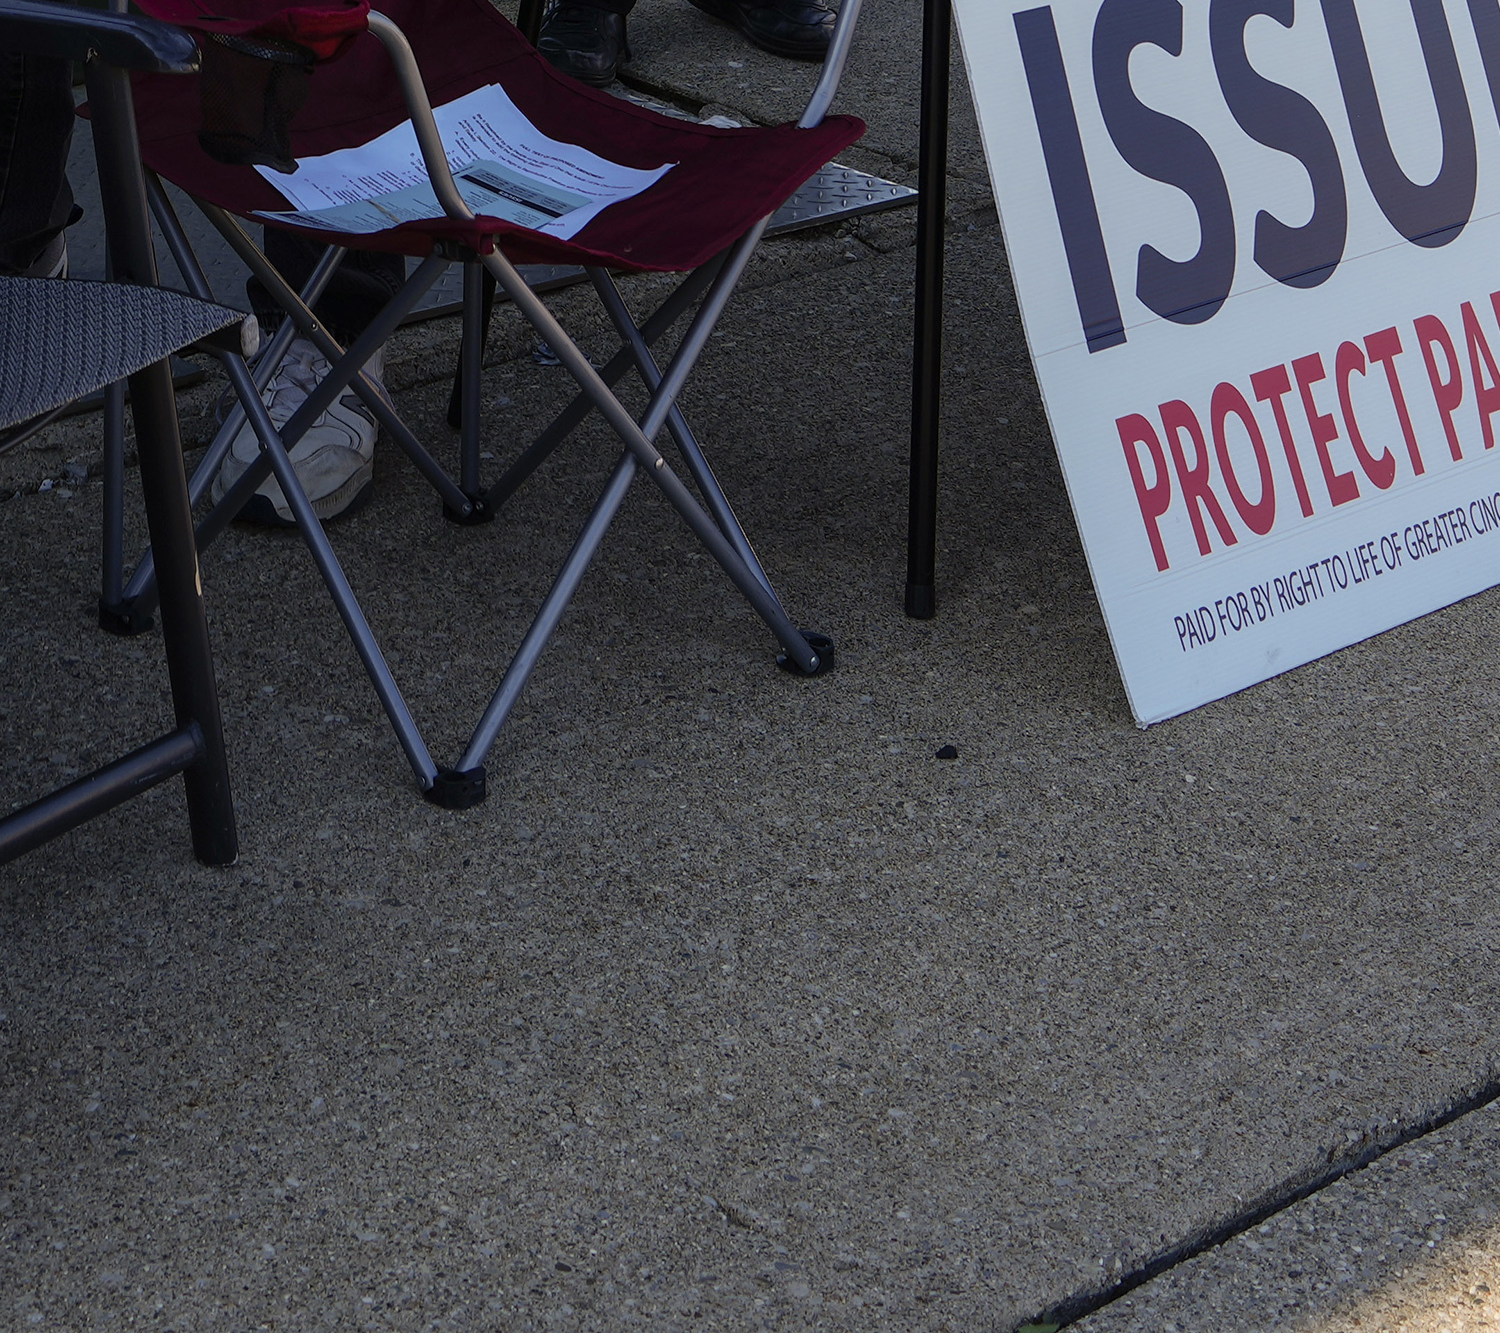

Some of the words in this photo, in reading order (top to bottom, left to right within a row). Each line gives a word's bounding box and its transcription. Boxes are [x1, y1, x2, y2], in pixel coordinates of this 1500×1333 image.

[1115, 325, 1426, 573] PROTECT
[1174, 606, 1217, 652] PAID
[1215, 591, 1255, 636] FOR
[1250, 581, 1275, 623] BY
[1273, 560, 1325, 614] RIGHT
[1321, 554, 1349, 592] TO
[1345, 541, 1383, 585] LIFE
[1379, 531, 1404, 572] OF
[1403, 506, 1471, 561] GREATER
